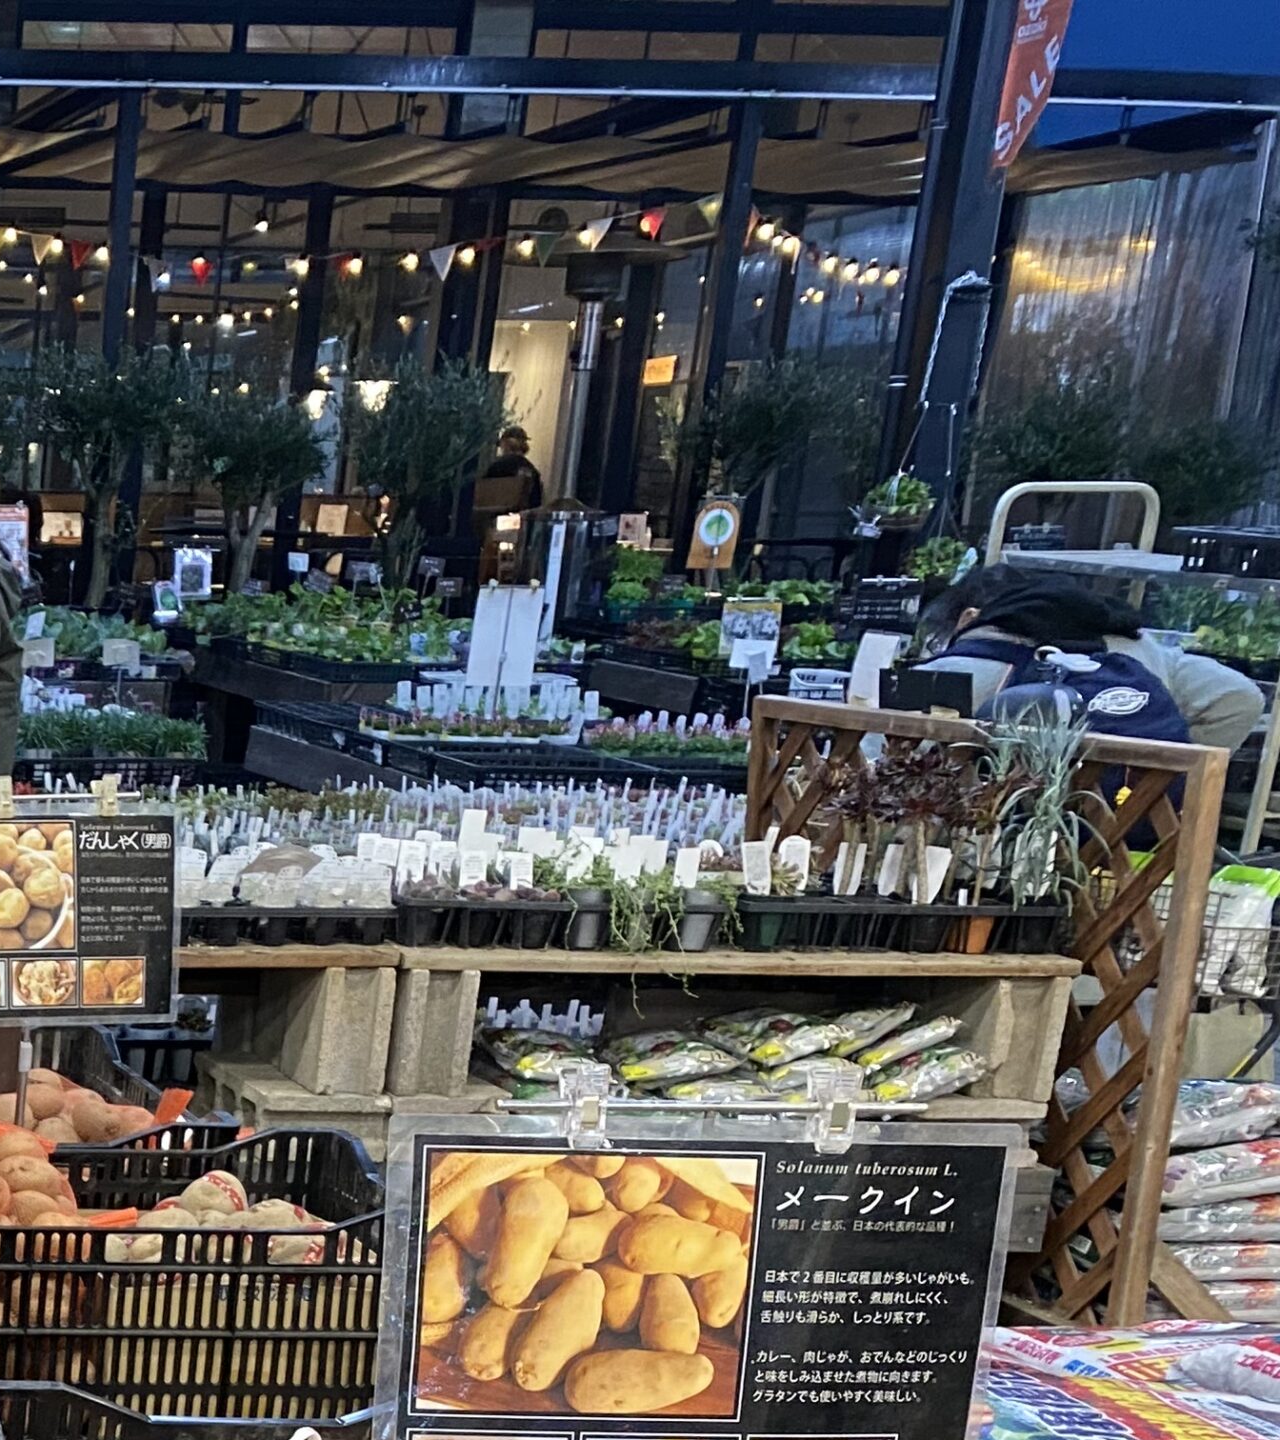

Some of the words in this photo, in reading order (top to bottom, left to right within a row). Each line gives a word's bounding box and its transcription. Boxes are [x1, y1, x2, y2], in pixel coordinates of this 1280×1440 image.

[776, 1161, 848, 1175] Solanum
[855, 1162, 938, 1177] tuberosum
[776, 1185, 955, 1215] メークイン
[756, 1350, 968, 1364] カレー、肉じゃが、おでんなどのじっくり
[754, 1370, 937, 1384] と味をしみ込ませた煮物に向きます。
[752, 1390, 921, 1403] グラタンでも使いやすく美味しい。
